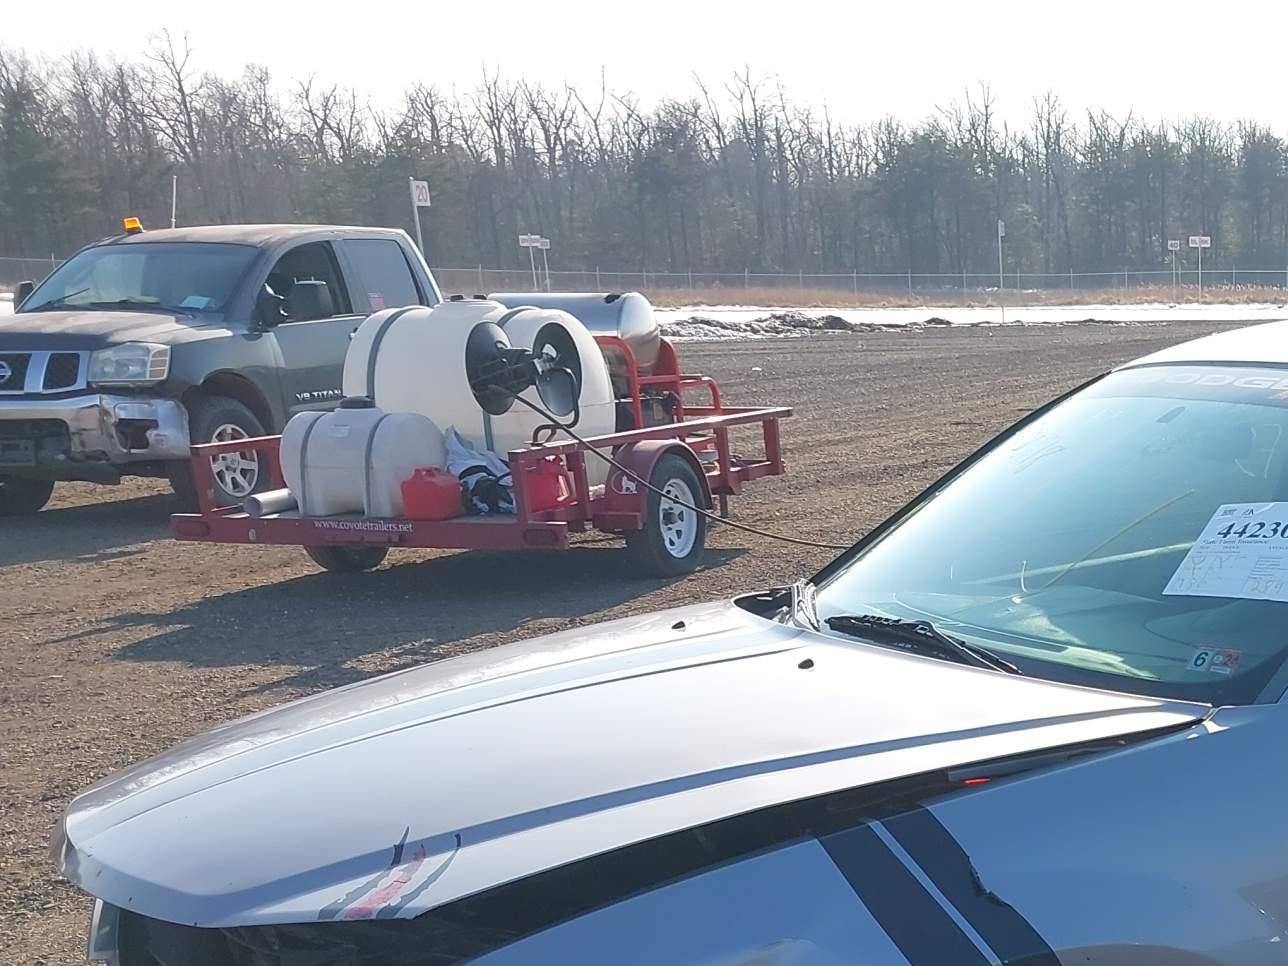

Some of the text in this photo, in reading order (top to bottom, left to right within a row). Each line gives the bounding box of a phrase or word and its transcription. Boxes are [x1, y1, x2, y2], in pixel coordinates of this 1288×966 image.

[415, 184, 428, 202] 20
[295, 390, 342, 401] V8 TITAN
[313, 519, 414, 533] www.coyotetrailers.net
[1193, 651, 1209, 667] 6
